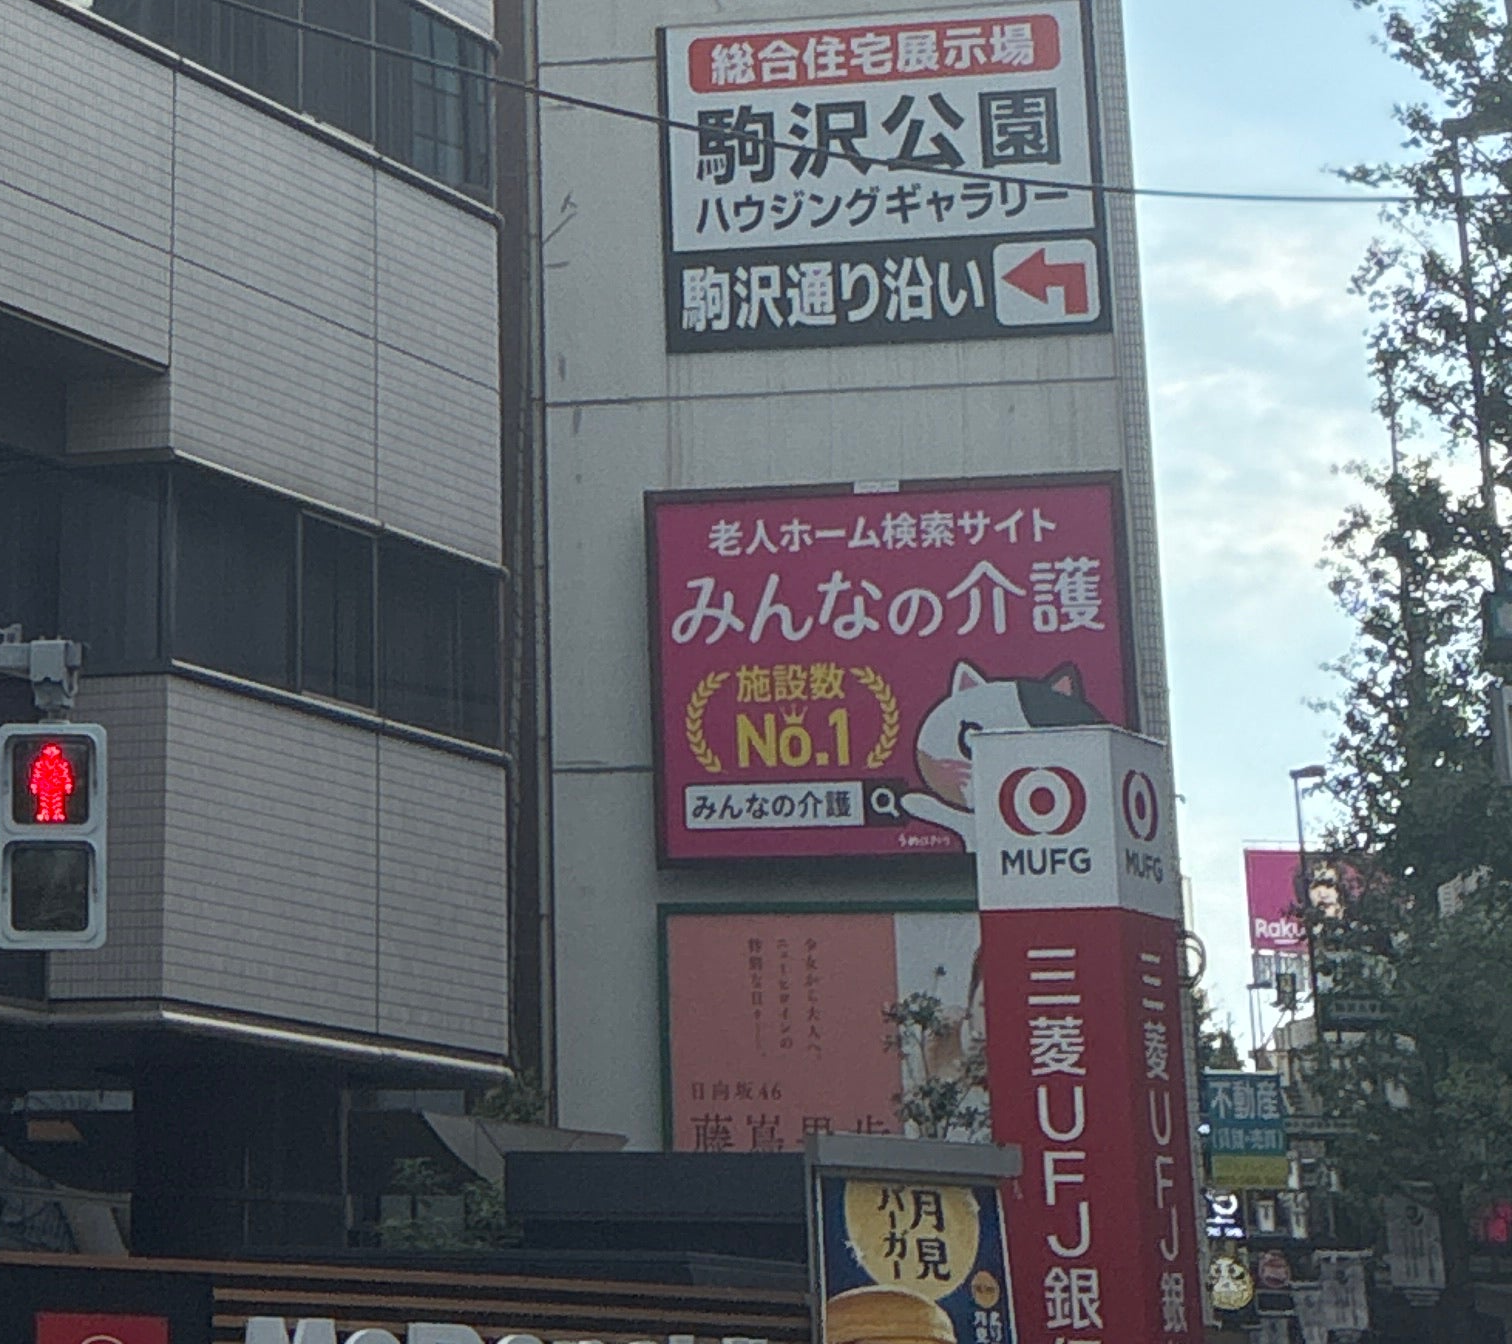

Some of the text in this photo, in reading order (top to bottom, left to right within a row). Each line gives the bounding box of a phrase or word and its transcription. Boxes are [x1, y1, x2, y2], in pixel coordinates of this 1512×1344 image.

[710, 23, 1035, 85] 総合住宅展示場
[696, 87, 1062, 185] 駒沢公園
[696, 182, 1070, 234] ハウジングギャラリー
[681, 256, 986, 332] 駒沢通り沿い
[708, 508, 1058, 556] 老人ホーム検索サイト
[670, 556, 1106, 644] みんなの介護
[736, 662, 847, 703] 施設数
[735, 707, 851, 769] No.1
[691, 789, 853, 821] みんなの介護
[1001, 847, 1092, 876] MUFG
[1125, 847, 1165, 886] MUFG
[1255, 918, 1305, 938] Raku
[691, 1081, 783, 1101] 日向坂46
[1209, 1081, 1280, 1120] 不動産
[1026, 948, 1104, 1344] 三菱UFJ銀
[1140, 952, 1188, 1344] 三菱UFJ銀
[877, 1186, 908, 1280] バーガー
[910, 1189, 950, 1281] 月見
